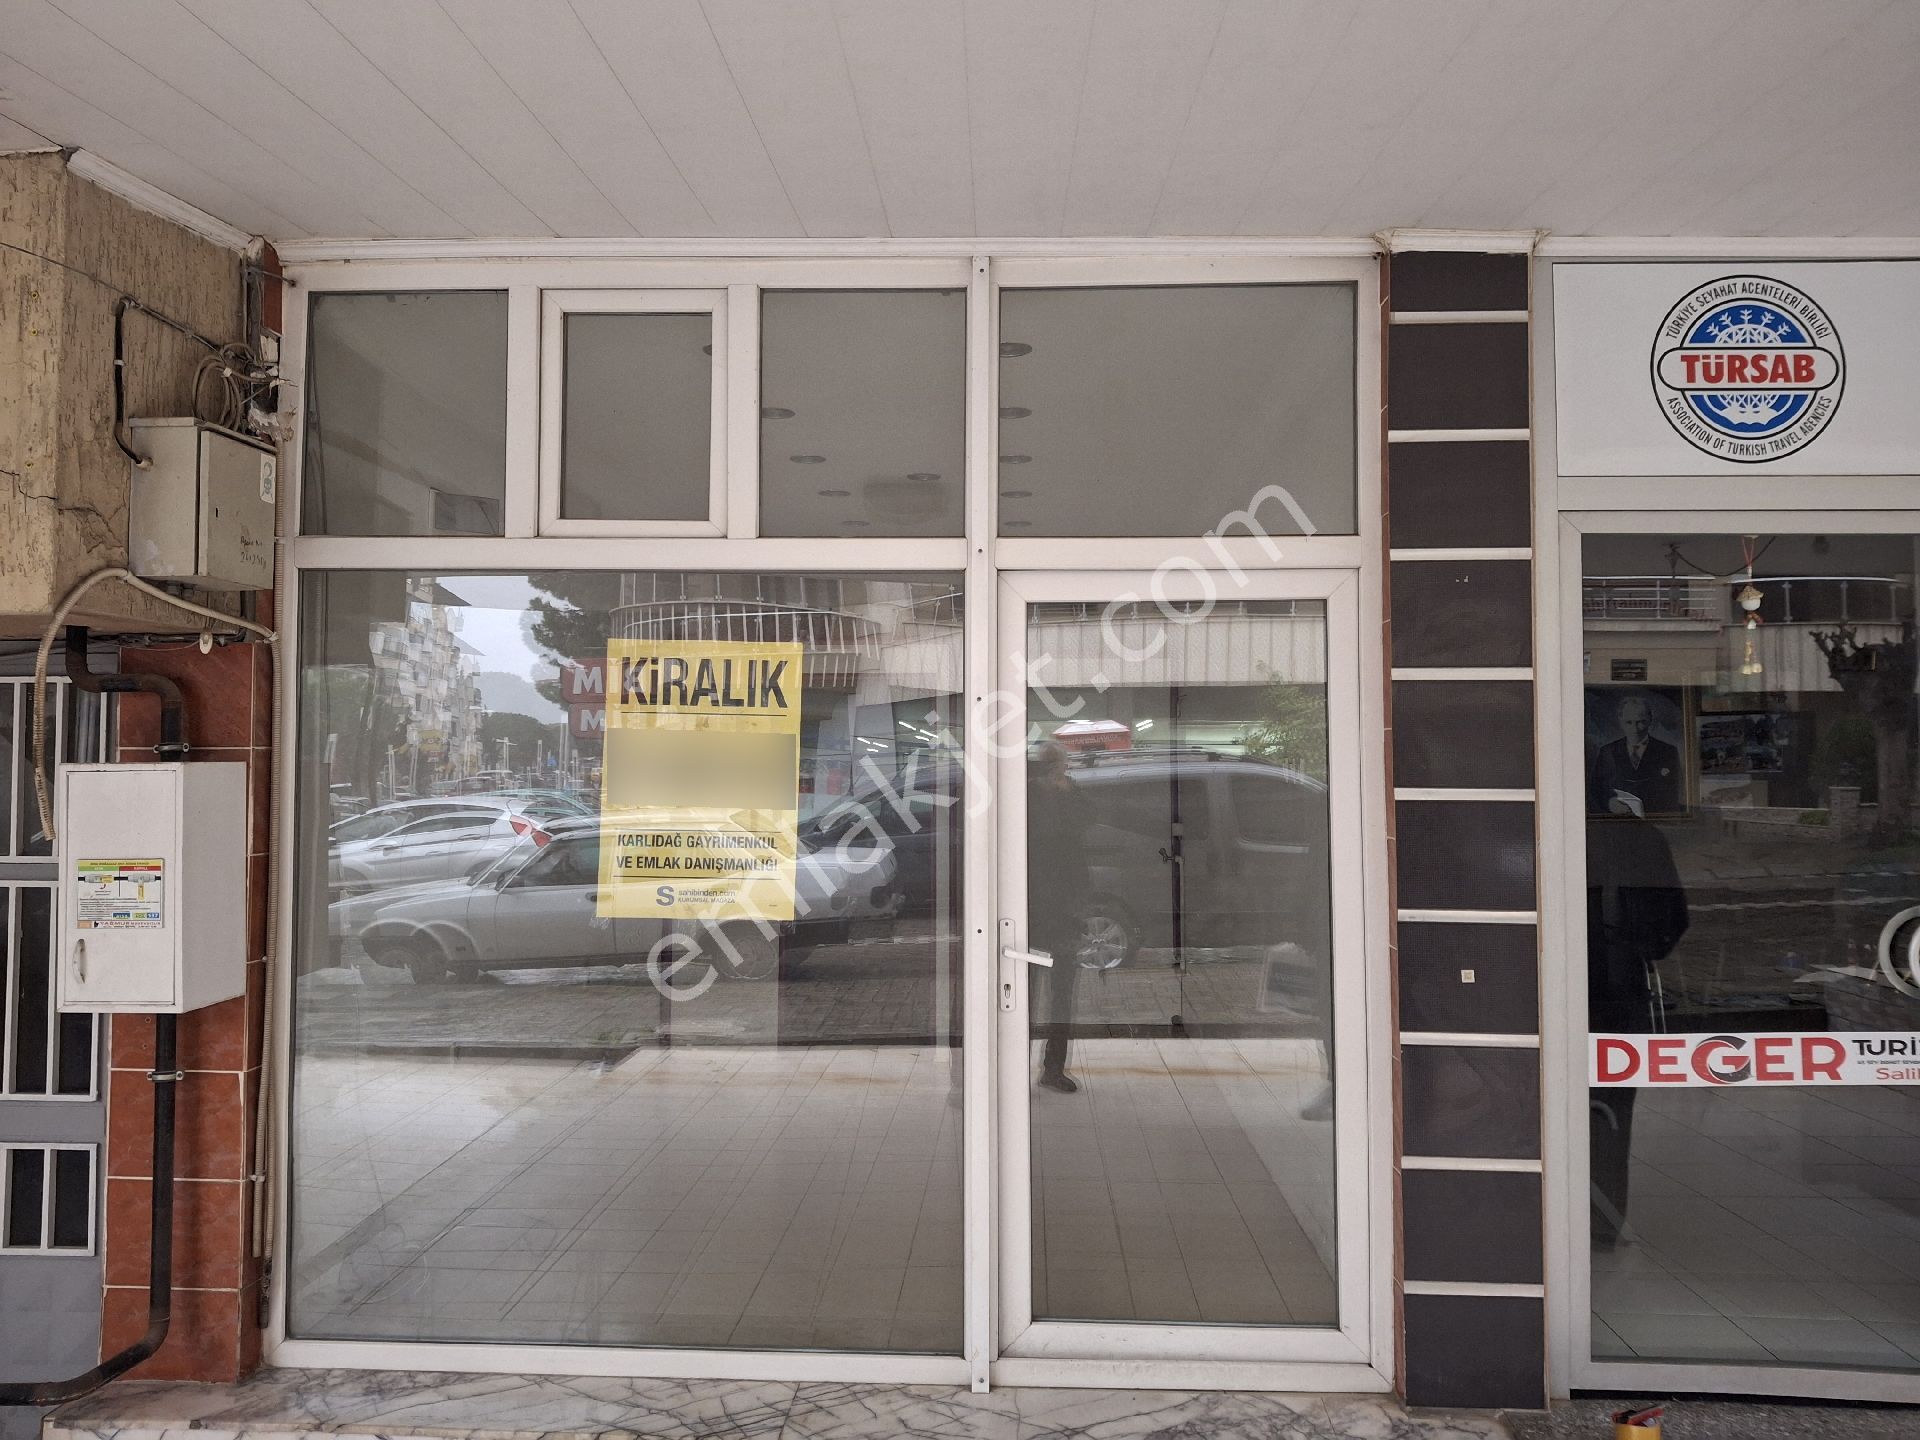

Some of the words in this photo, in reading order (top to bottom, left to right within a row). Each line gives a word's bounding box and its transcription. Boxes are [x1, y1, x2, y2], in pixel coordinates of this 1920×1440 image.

[1666, 299, 1698, 340] TÜRKİYE
[1695, 282, 1738, 309] SEYAHAT
[1741, 281, 1802, 310] ACENTELERİ
[1800, 305, 1831, 340] BİRLİĞİ
[1681, 354, 1816, 384] TÜRSAB
[1666, 395, 1714, 444] ASSOCIATION
[1713, 437, 1726, 451] OF
[1727, 441, 1768, 457] TURKISH
[1767, 431, 1802, 456] TRAVEL
[1800, 394, 1833, 438] AGENCIES
[617, 832, 682, 848] KARLIDAĞ
[687, 833, 778, 849] GAYRİMENKUL
[616, 856, 633, 868] VE
[636, 856, 681, 869] EMLAK
[684, 857, 778, 873] DANIŞMANLIĞI
[678, 888, 736, 897] sahibinden.com
[1852, 1036, 1920, 1056] TURİ
